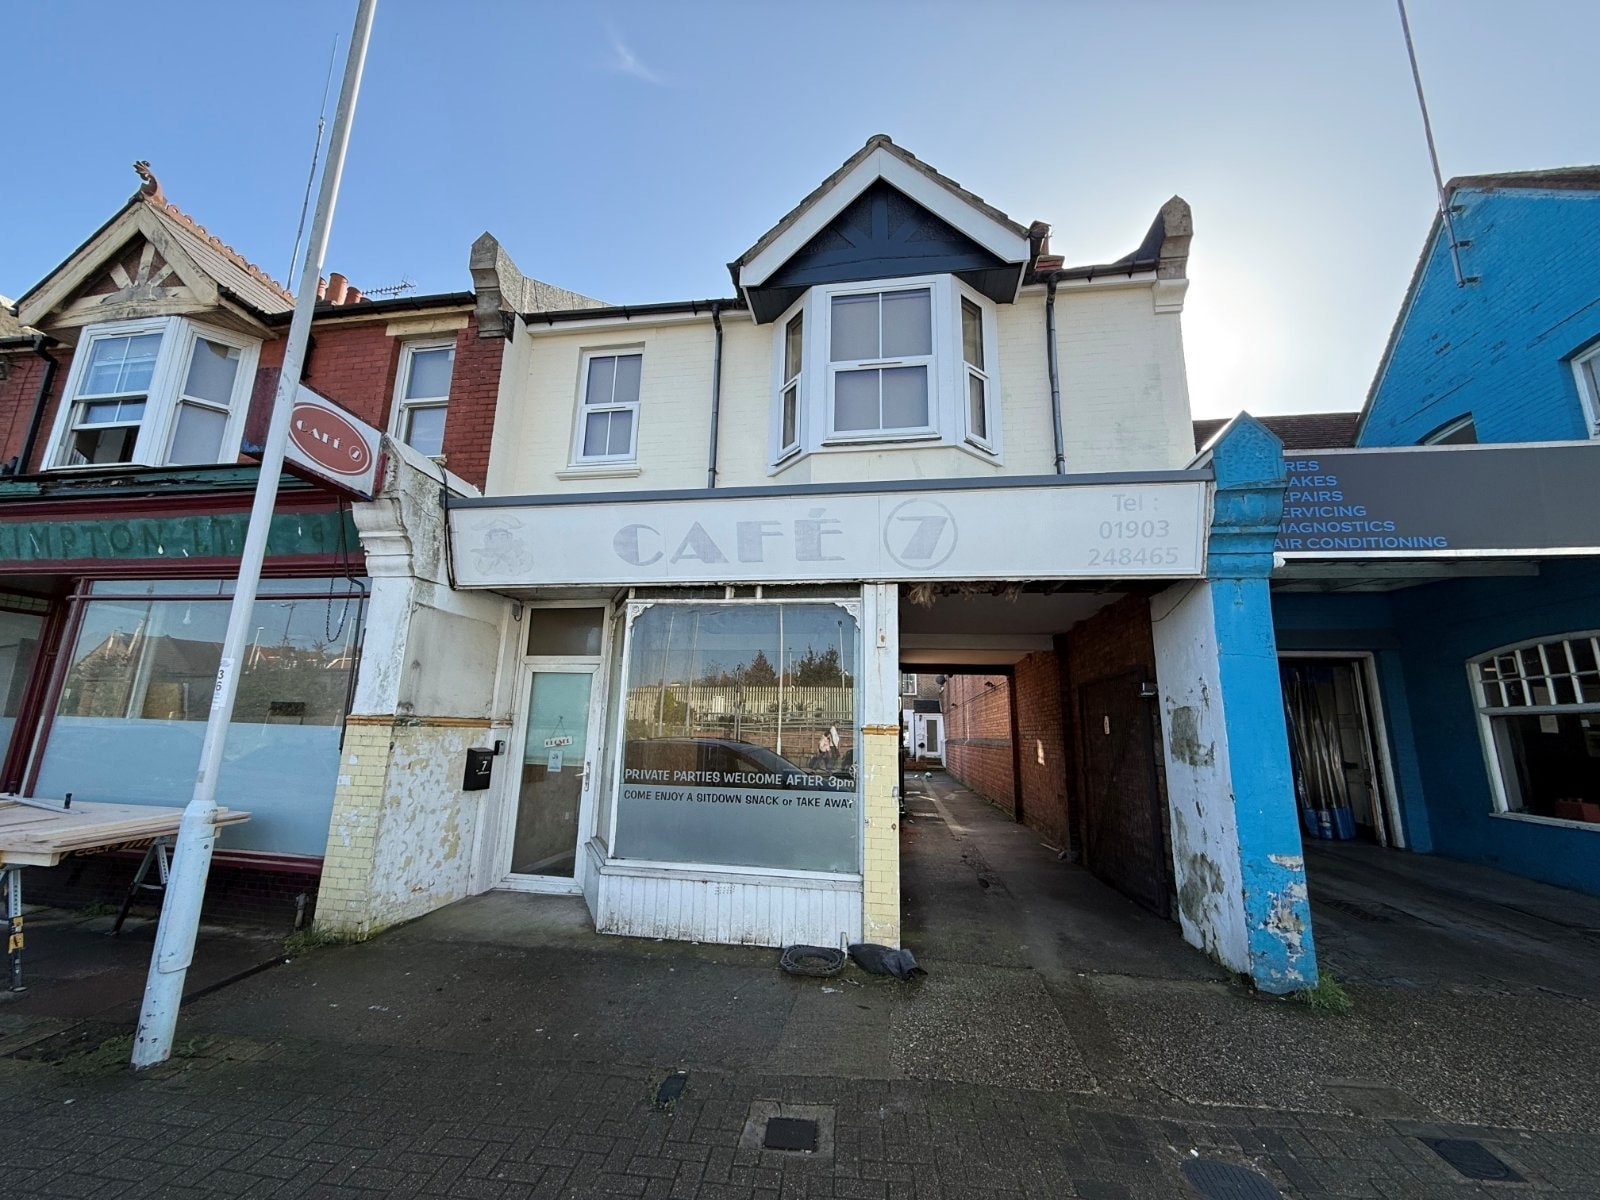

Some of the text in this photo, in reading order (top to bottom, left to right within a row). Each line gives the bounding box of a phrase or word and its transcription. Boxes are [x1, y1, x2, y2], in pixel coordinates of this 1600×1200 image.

[1284, 460, 1320, 472] RES
[1289, 475, 1338, 487] AKES
[1112, 493, 1144, 512] Tel
[1284, 490, 1344, 503] PAIRS
[1282, 505, 1367, 518] ERVICING
[1099, 520, 1170, 540] 01903
[1279, 521, 1396, 534] IAGNOSTICS
[613, 508, 948, 566] CAFÉ 7
[1273, 536, 1448, 550] AIR CONDITIONING
[1087, 547, 1179, 567] 248465
[625, 768, 855, 790] PRIVATE PARTIES WELCOME AFTER 3pm
[624, 789, 854, 809] COME ENJOY A SITDOWN SNACK or TAKE AWAY
